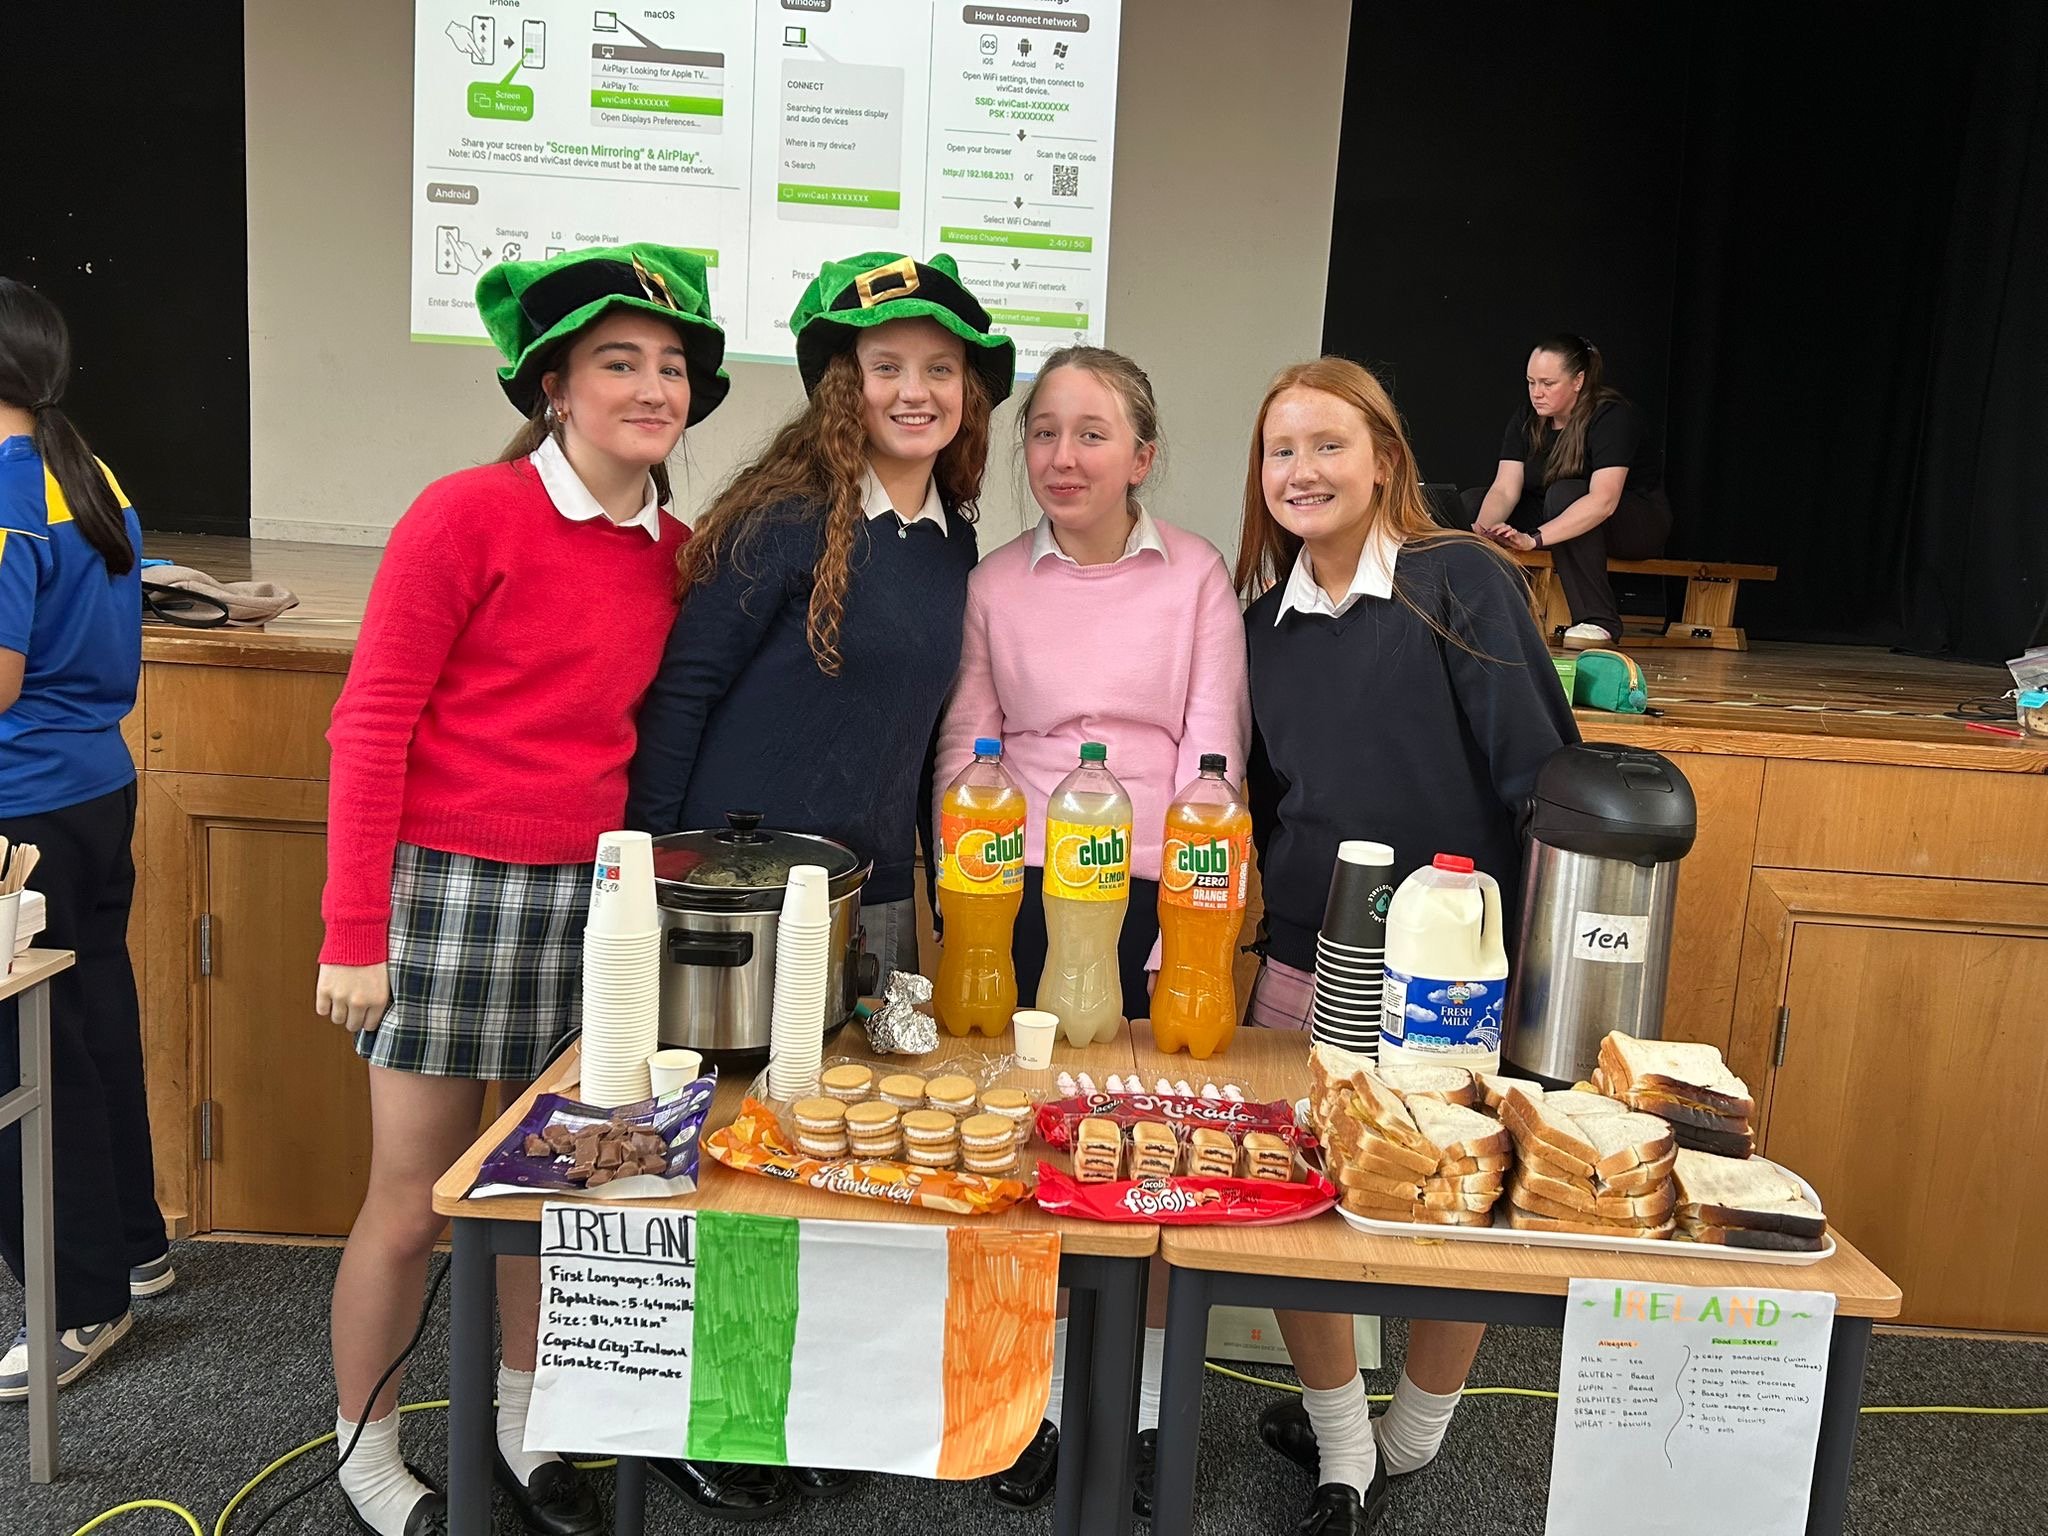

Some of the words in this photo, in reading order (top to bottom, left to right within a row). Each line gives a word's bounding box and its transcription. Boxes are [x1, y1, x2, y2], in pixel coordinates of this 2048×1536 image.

[644, 10, 675, 20] macOS
[975, 11, 994, 21] How
[996, 12, 1005, 21] to
[1006, 14, 1041, 25] connect
[1042, 17, 1078, 28] network
[982, 40, 995, 49] iOS
[1012, 60, 1036, 69] Android
[602, 64, 629, 75] AirPlay:
[630, 66, 658, 77] Looking
[660, 69, 670, 77] for
[671, 69, 692, 79] Apple
[787, 80, 824, 91] CONNECT
[962, 71, 981, 81] Open
[982, 72, 998, 81] WiFi
[999, 74, 1029, 85] settings,
[1030, 76, 1046, 85] then
[1047, 78, 1075, 87] connect
[1077, 80, 1084, 88] to
[601, 81, 626, 92] AirPlay
[628, 83, 639, 92] To:
[996, 85, 1023, 94] viviCast
[1025, 86, 1050, 96] device.
[495, 90, 520, 99] Screen
[495, 102, 527, 114] Mirroring
[975, 97, 995, 107] SSID:
[786, 103, 821, 115] Searching
[823, 106, 833, 115] for
[834, 107, 862, 117] wireless
[864, 109, 888, 120] display
[989, 109, 1005, 118] PSK
[601, 112, 620, 122] Open
[622, 114, 651, 125] Displays
[786, 114, 799, 122] and
[801, 115, 821, 124] audio
[822, 117, 848, 126] devices
[461, 138, 484, 148] Share
[486, 140, 504, 150] your
[506, 142, 532, 152] screen
[534, 143, 544, 153] by
[647, 148, 654, 159] &
[785, 138, 808, 147] Where
[809, 140, 815, 148] is
[817, 141, 827, 150] my
[829, 141, 856, 151] device?
[947, 143, 965, 152] Open
[967, 145, 982, 155] your
[984, 146, 1012, 156] browser
[1036, 149, 1053, 159] Scan
[1055, 151, 1066, 160] the
[1067, 152, 1078, 161] QR
[1079, 153, 1096, 162] code
[449, 149, 470, 159] Note:
[472, 150, 486, 160] iOS
[493, 152, 521, 162] macOS
[523, 154, 538, 163] and
[541, 155, 571, 166] viviCast
[573, 157, 599, 168] device
[600, 159, 620, 169] must
[621, 160, 632, 170] be
[634, 162, 642, 170] at
[643, 162, 657, 172] the
[658, 164, 679, 173] same
[681, 165, 715, 175] network.
[791, 160, 816, 170] Search
[1024, 172, 1033, 181] or
[435, 187, 470, 200] Android
[983, 215, 1005, 225] Select
[1006, 216, 1022, 226] WiFi
[1023, 218, 1051, 227] Channel
[496, 228, 528, 239] Samsung
[551, 231, 562, 240] LG
[575, 233, 600, 244] Google
[602, 235, 619, 243] Pixel
[948, 231, 978, 241] Wireless
[980, 233, 1008, 243] Channel
[792, 270, 815, 280] Press
[962, 277, 991, 287] Connect
[993, 280, 1004, 288] the
[1006, 281, 1020, 290] your
[1022, 280, 1038, 290] WiFi
[1038, 282, 1067, 291] network
[428, 297, 449, 307] Enter
[1079, 829, 1123, 866] club
[1178, 836, 1227, 873] club
[1098, 872, 1125, 884] LEMON
[1193, 888, 1229, 902] ORANGE
[1441, 1006, 1473, 1017] FRESH
[1442, 1016, 1470, 1026] MILK
[1133, 1095, 1256, 1124] Mikado
[810, 1165, 916, 1205] Kimberley
[549, 1265, 584, 1282] First
[1613, 1288, 1780, 1328] IRELAND
[549, 1311, 587, 1327] Size:
[542, 1332, 596, 1350] Capital
[1577, 1370, 1613, 1379] GLUTEN
[1578, 1384, 1604, 1392] LUPIN
[1574, 1420, 1603, 1429] WHEAT
